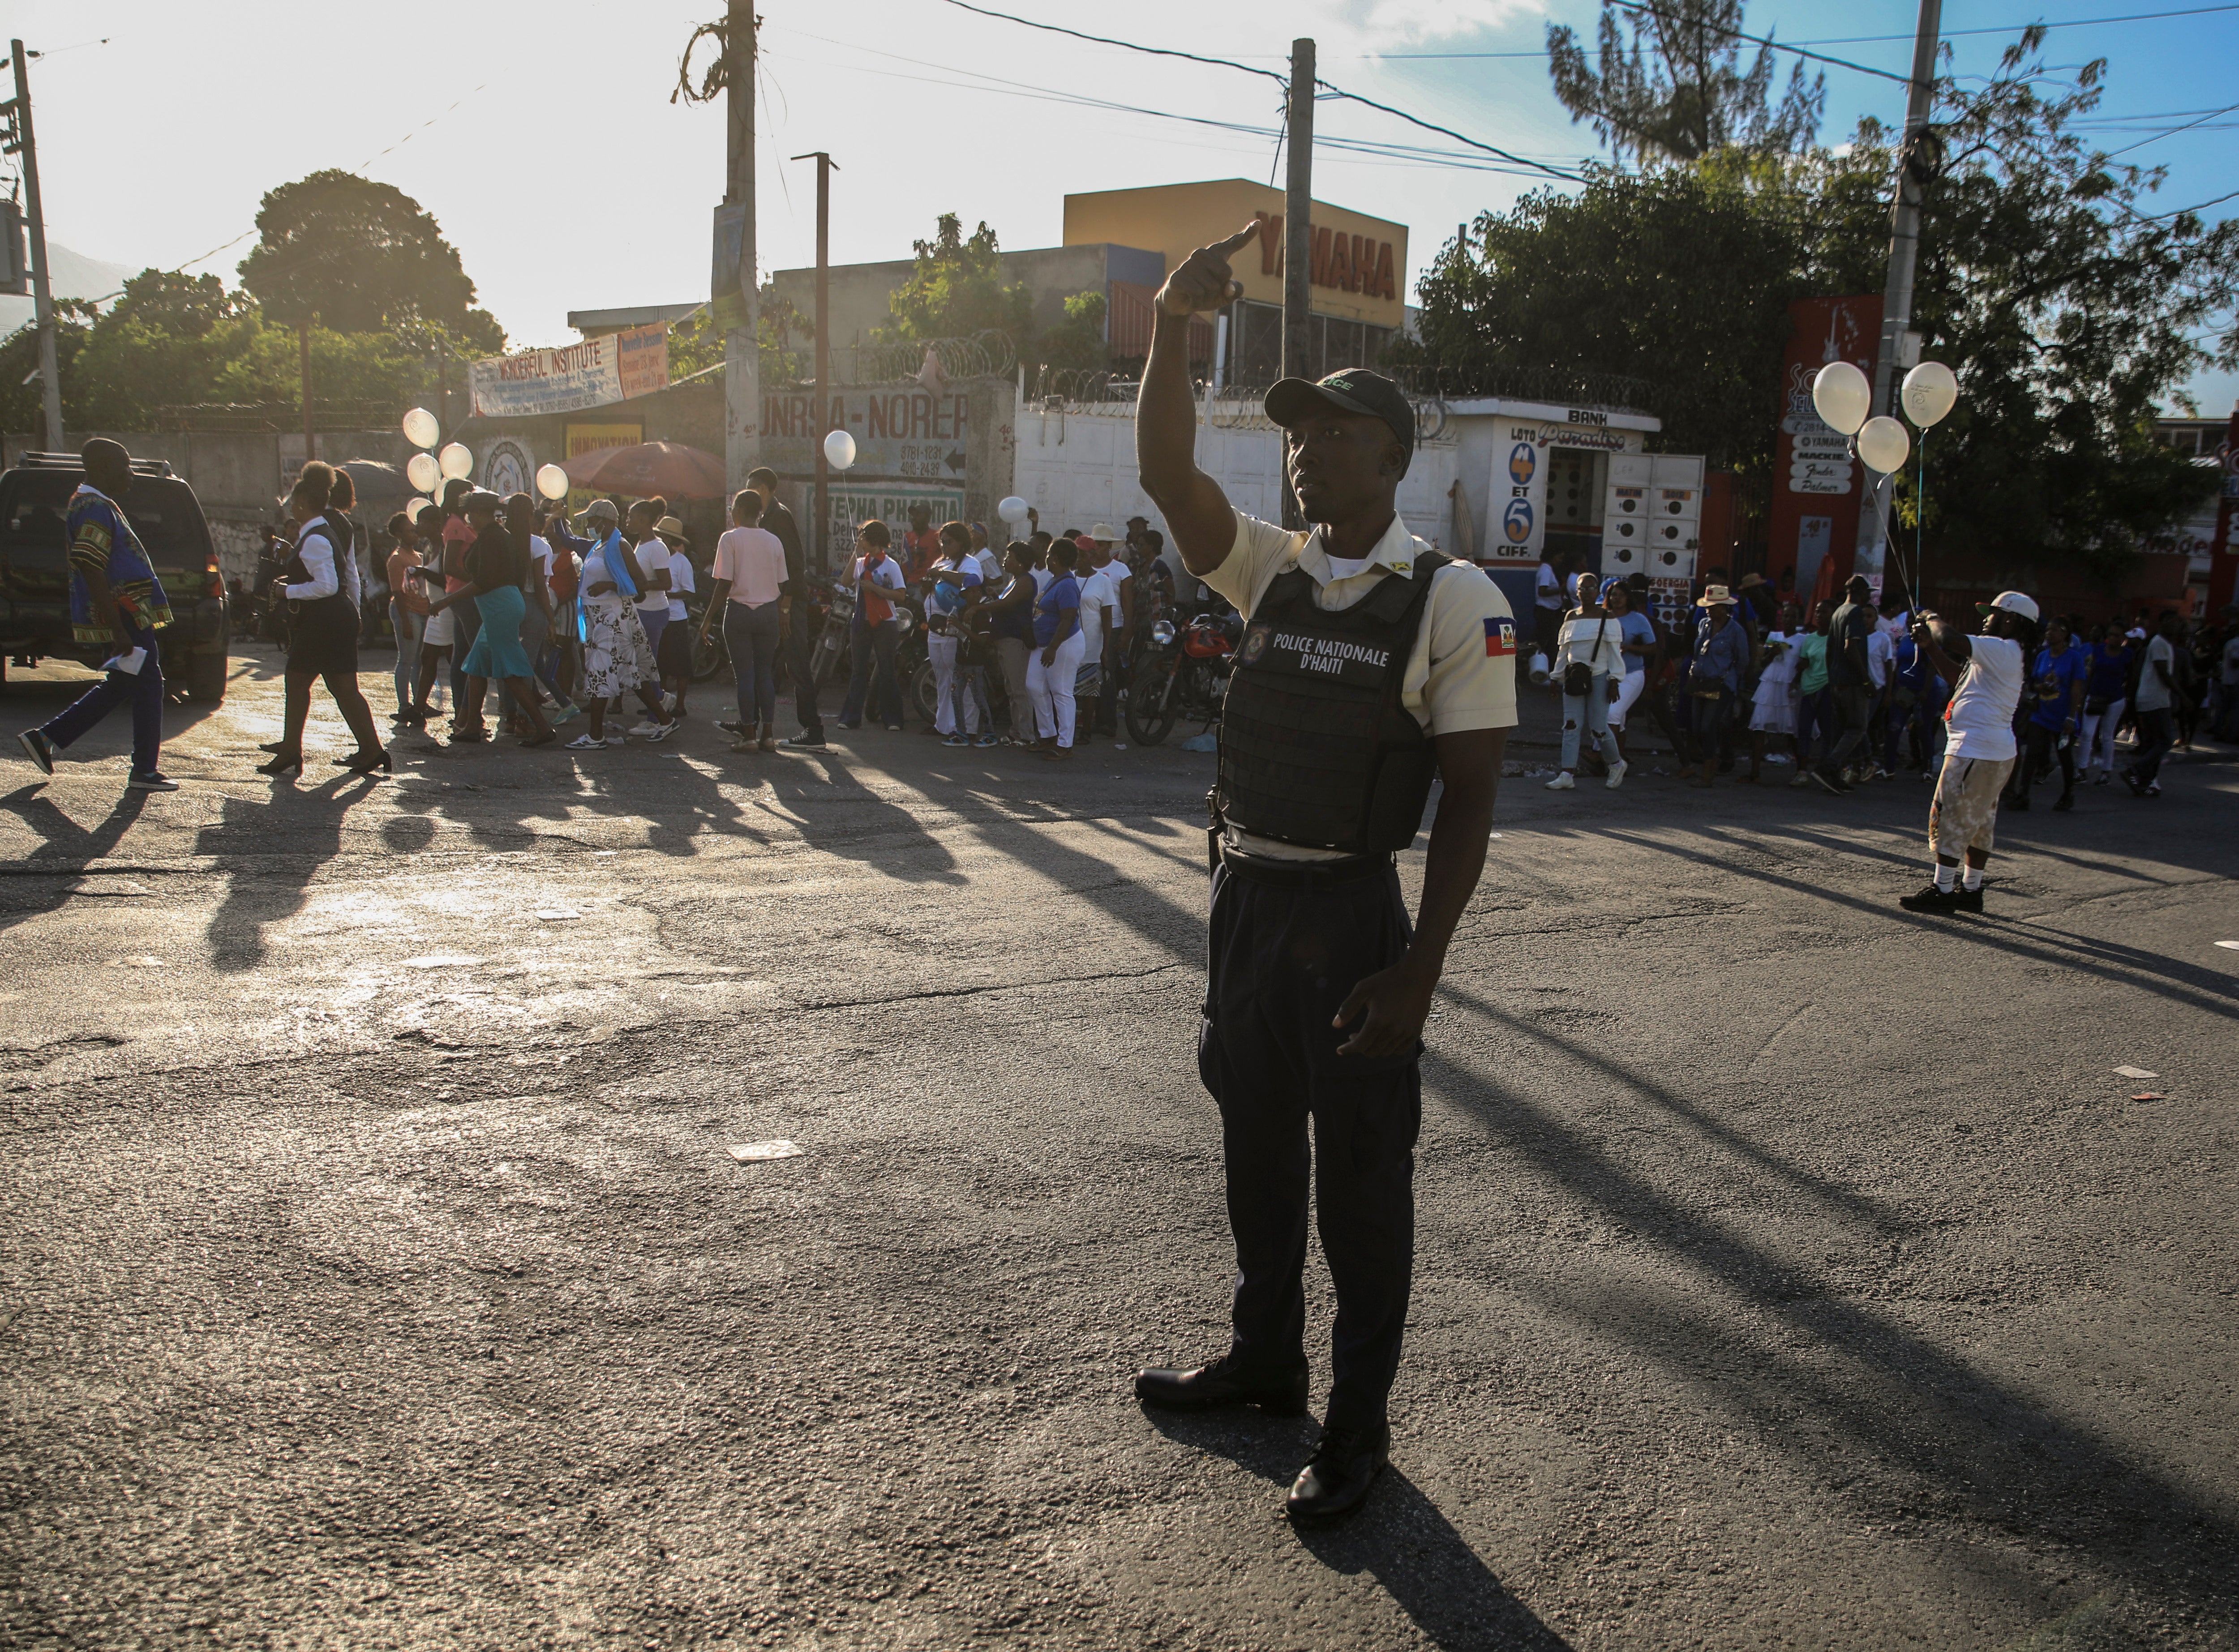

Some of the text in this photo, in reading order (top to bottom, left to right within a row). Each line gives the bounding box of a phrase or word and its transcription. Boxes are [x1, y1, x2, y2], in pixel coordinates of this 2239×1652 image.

[1255, 211, 1396, 301] YMAHA
[499, 354, 548, 381] WONDERFUL
[551, 341, 602, 375] INSTITUTE
[1511, 424, 1625, 450] LOTO Paradise
[1812, 437, 1846, 447] YAMAHA
[901, 445, 942, 460] 3781-1231
[901, 461, 940, 476] 4010-2439
[1511, 446, 1534, 482] 4
[1805, 464, 1836, 478] Fender
[1511, 486, 1530, 498] ET
[1617, 488, 1685, 499] MATIN SOIR
[1800, 480, 1838, 492] Palmer
[813, 496, 958, 524] TEPHA PHMA
[1507, 503, 1530, 542] 5
[1496, 545, 1530, 558] CIFF.
[1273, 633, 1390, 668] POLICE NATIONALE
[1300, 653, 1344, 675] D'HAITI
